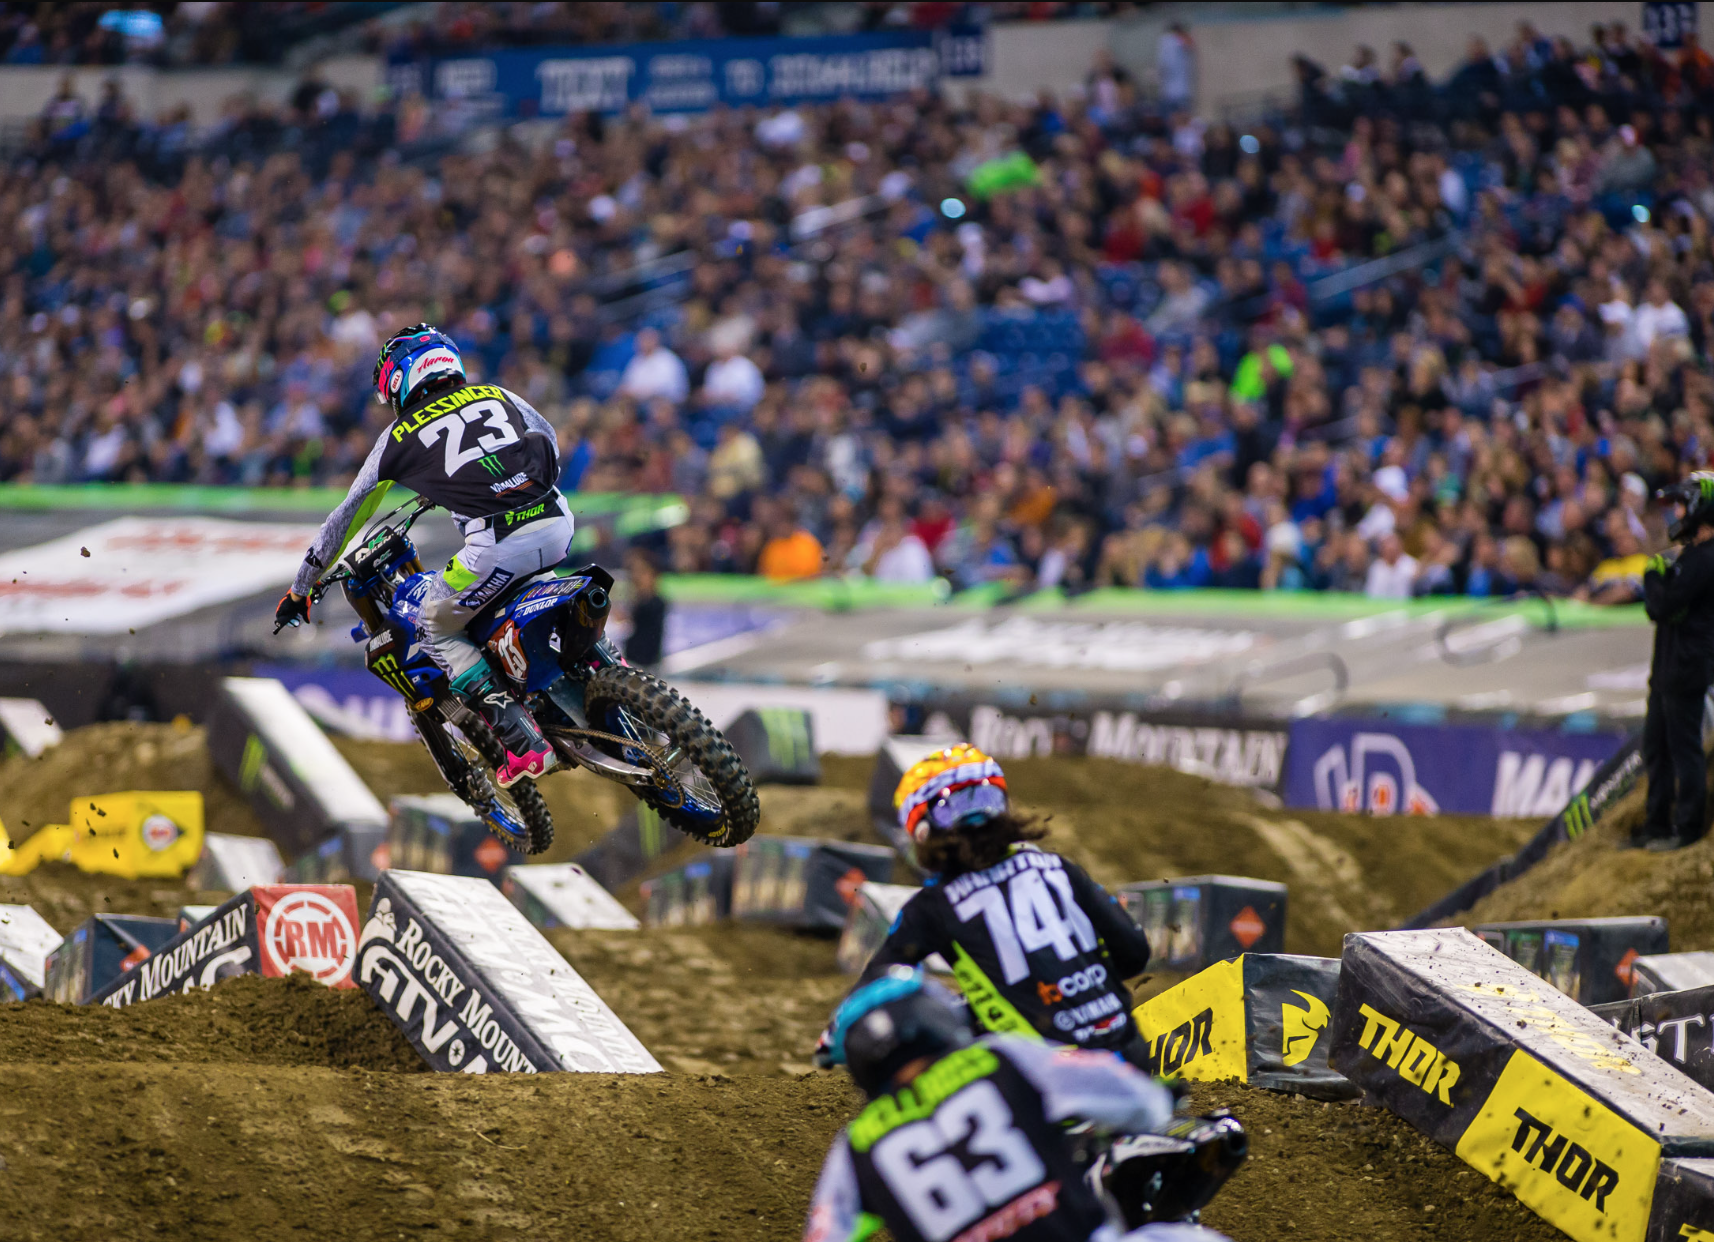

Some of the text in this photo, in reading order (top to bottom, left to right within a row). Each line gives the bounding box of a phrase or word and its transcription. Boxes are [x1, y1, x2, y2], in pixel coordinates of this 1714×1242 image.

[417, 356, 454, 374] Aaron
[391, 385, 507, 443] PLESSINGER
[418, 399, 520, 478] 23
[490, 471, 529, 493] YAMALUBE
[515, 503, 545, 521] THOR
[478, 572, 510, 602] YAMAHA
[522, 597, 559, 616] DUNLOP
[140, 903, 248, 1001] MOUNTAIN
[283, 921, 343, 959] RM
[396, 918, 466, 1007] ROCKY
[1149, 1007, 1213, 1077] HOR
[1358, 1003, 1462, 1108] THOR
[871, 1079, 1047, 1242] 63
[1512, 1107, 1619, 1213] THOR
